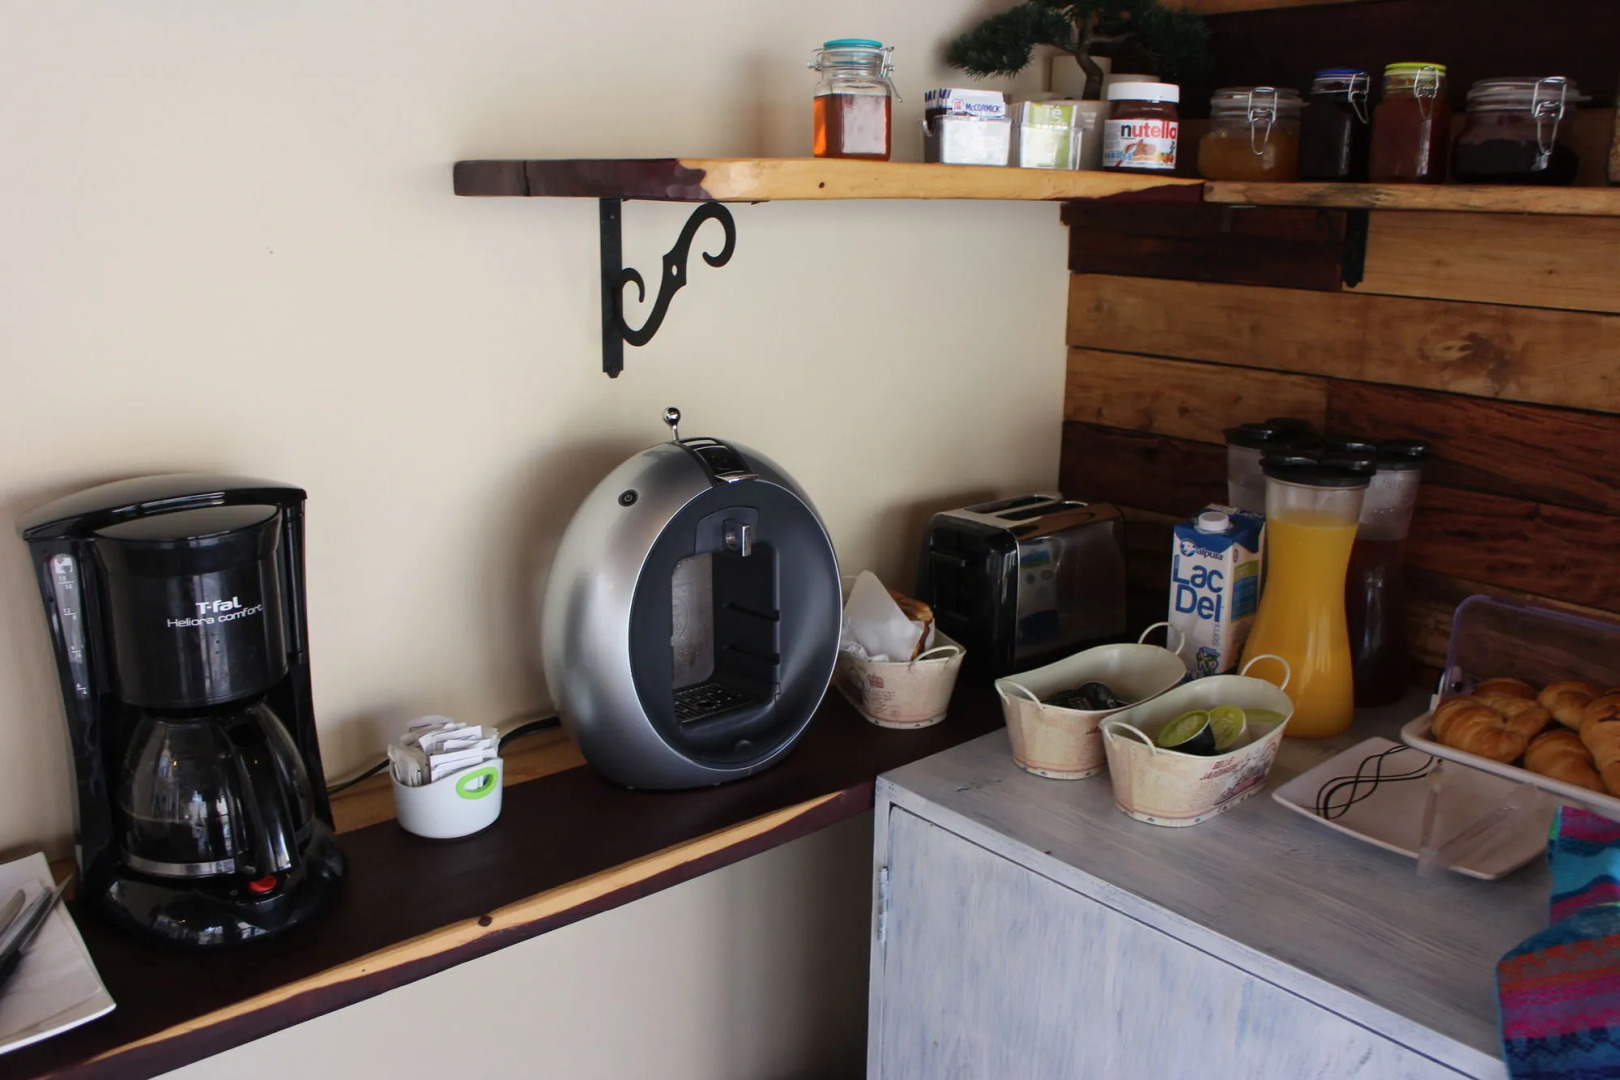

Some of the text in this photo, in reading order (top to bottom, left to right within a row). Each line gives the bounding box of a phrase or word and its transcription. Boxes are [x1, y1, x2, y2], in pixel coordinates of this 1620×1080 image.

[1120, 120, 1177, 139] nutella
[1196, 548, 1224, 561] alpura
[1172, 554, 1224, 593] Lac
[195, 596, 242, 615] T-fal
[1175, 583, 1222, 623] Del
[167, 604, 263, 628] Heliora comfort
